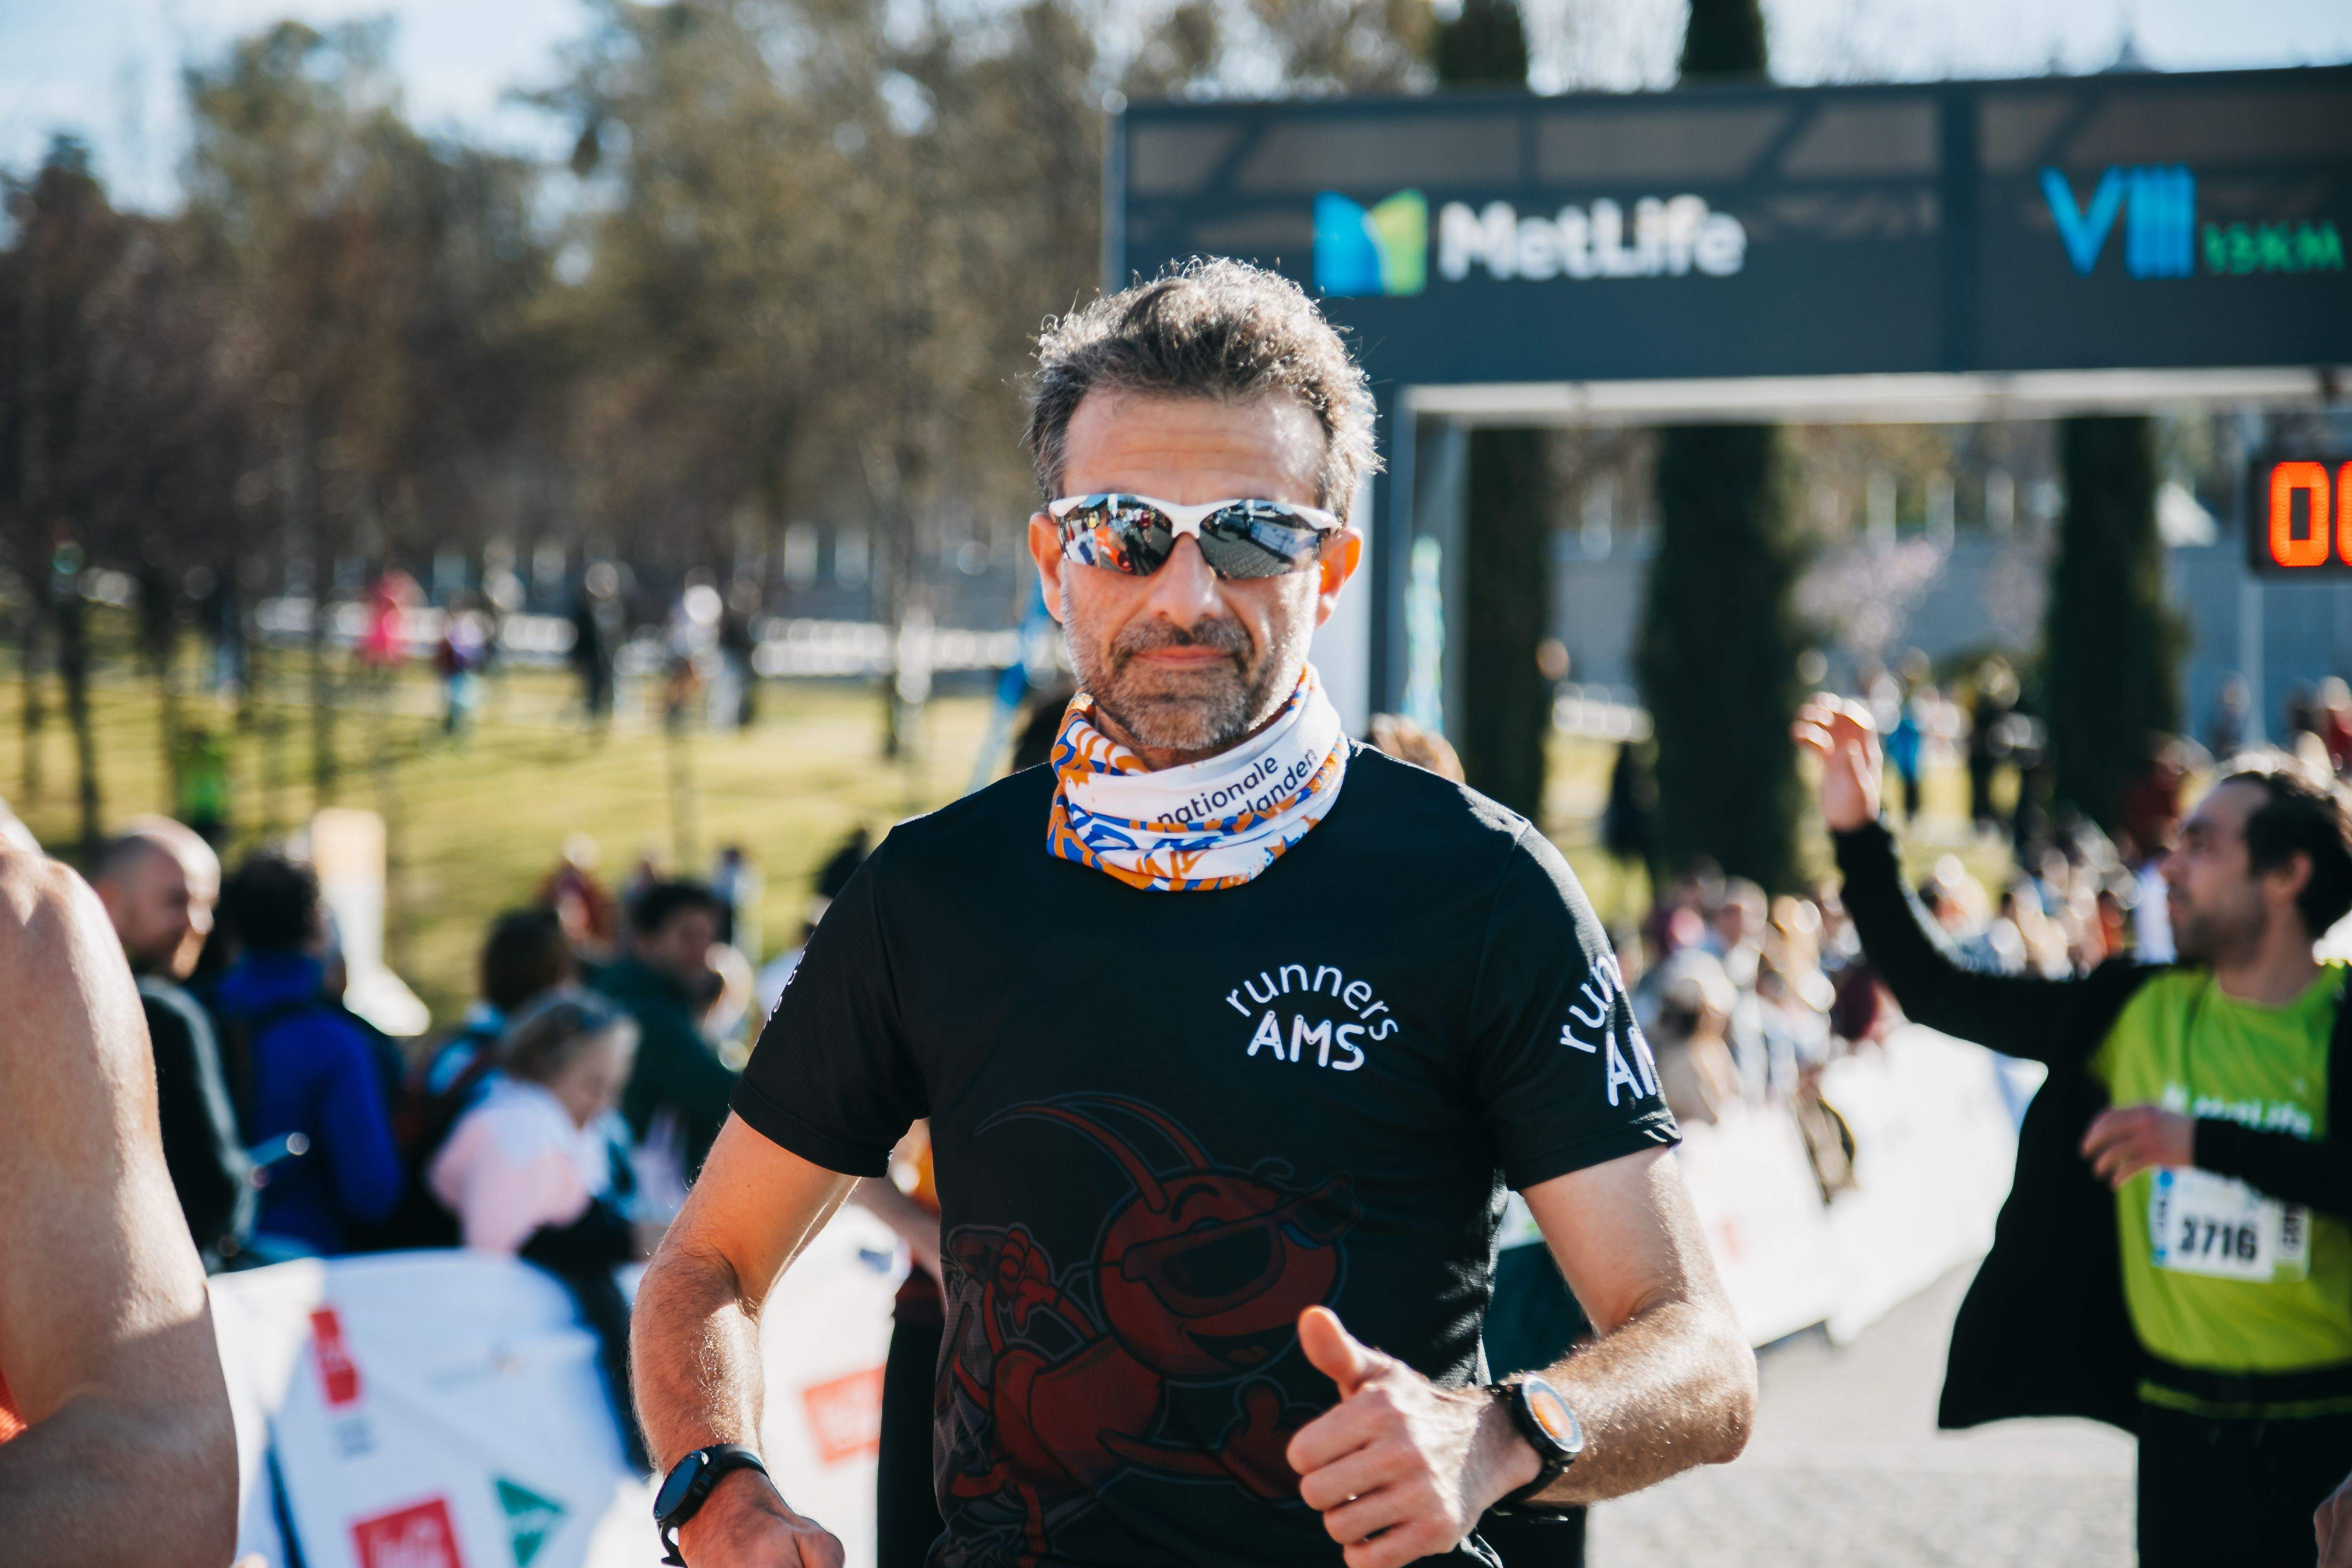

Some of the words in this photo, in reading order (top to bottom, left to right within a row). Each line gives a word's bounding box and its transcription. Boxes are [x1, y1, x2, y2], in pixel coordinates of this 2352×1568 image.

[1439, 195, 1747, 280] MetLife
[2038, 163, 2196, 280] VIII
[2268, 461, 2352, 567] 0
[1157, 757, 1278, 823] nationale
[1225, 964, 1399, 1041] runners
[1247, 1010, 1365, 1071] AMS
[1560, 953, 1625, 1054] run
[2180, 1216, 2258, 1264] 3716
